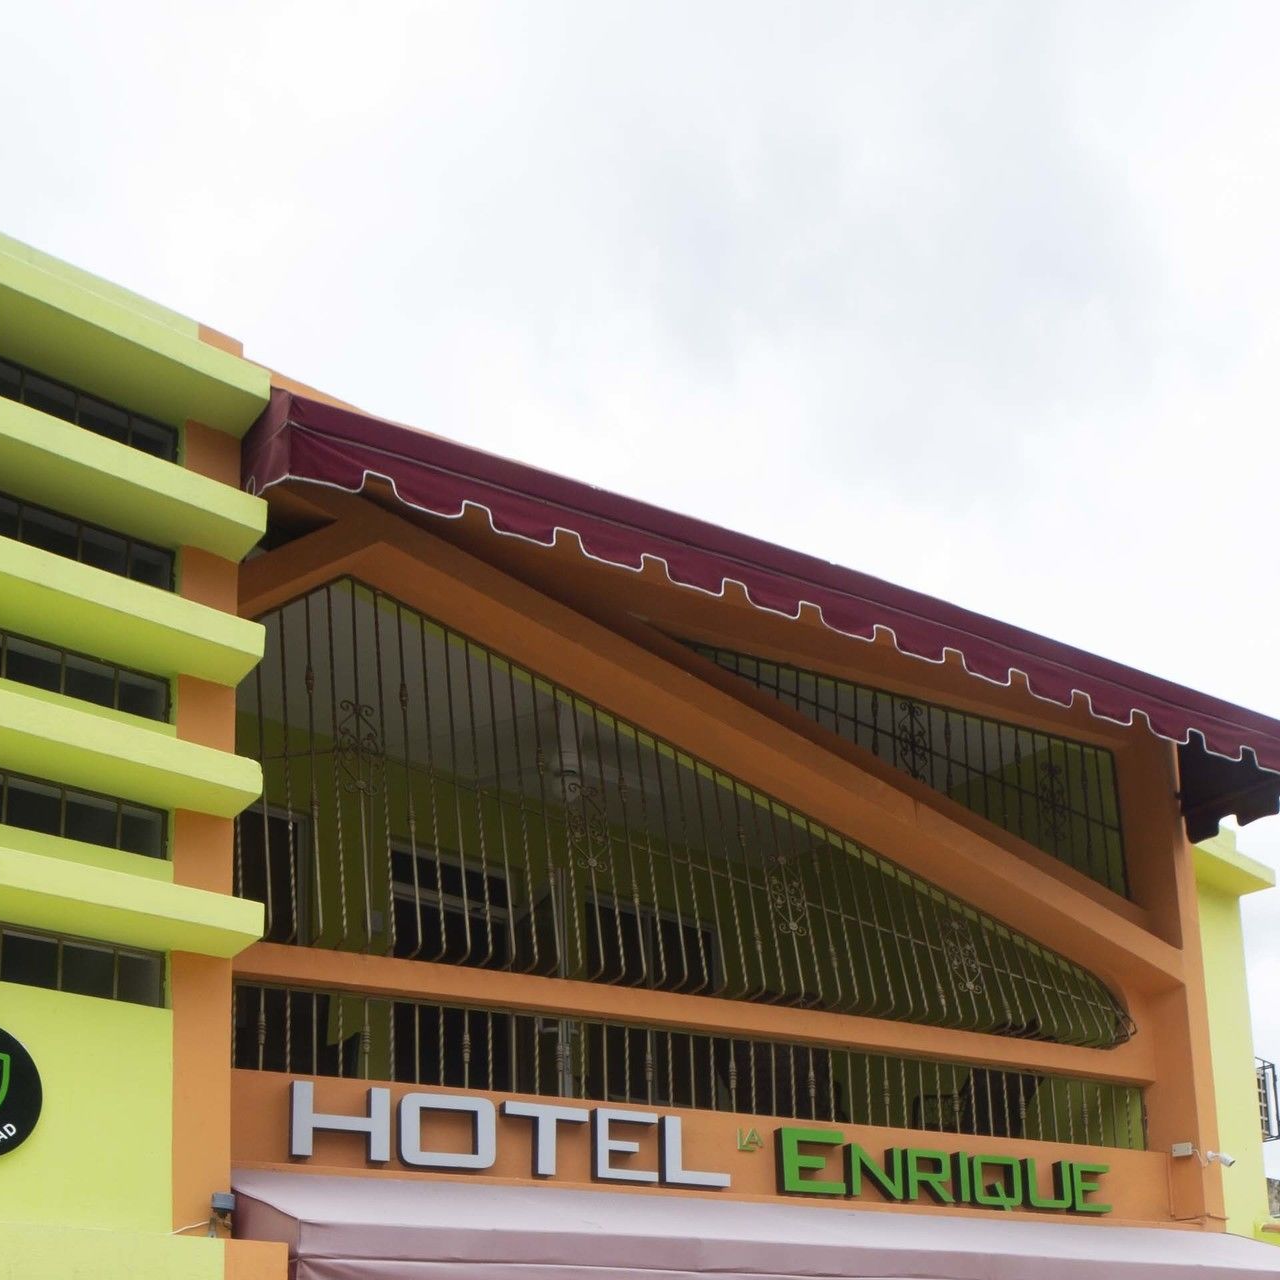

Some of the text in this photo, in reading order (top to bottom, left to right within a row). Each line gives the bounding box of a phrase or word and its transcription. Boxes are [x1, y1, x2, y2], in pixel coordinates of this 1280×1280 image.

[289, 1080, 1113, 1214] HOTEL LA ENRIQUE
